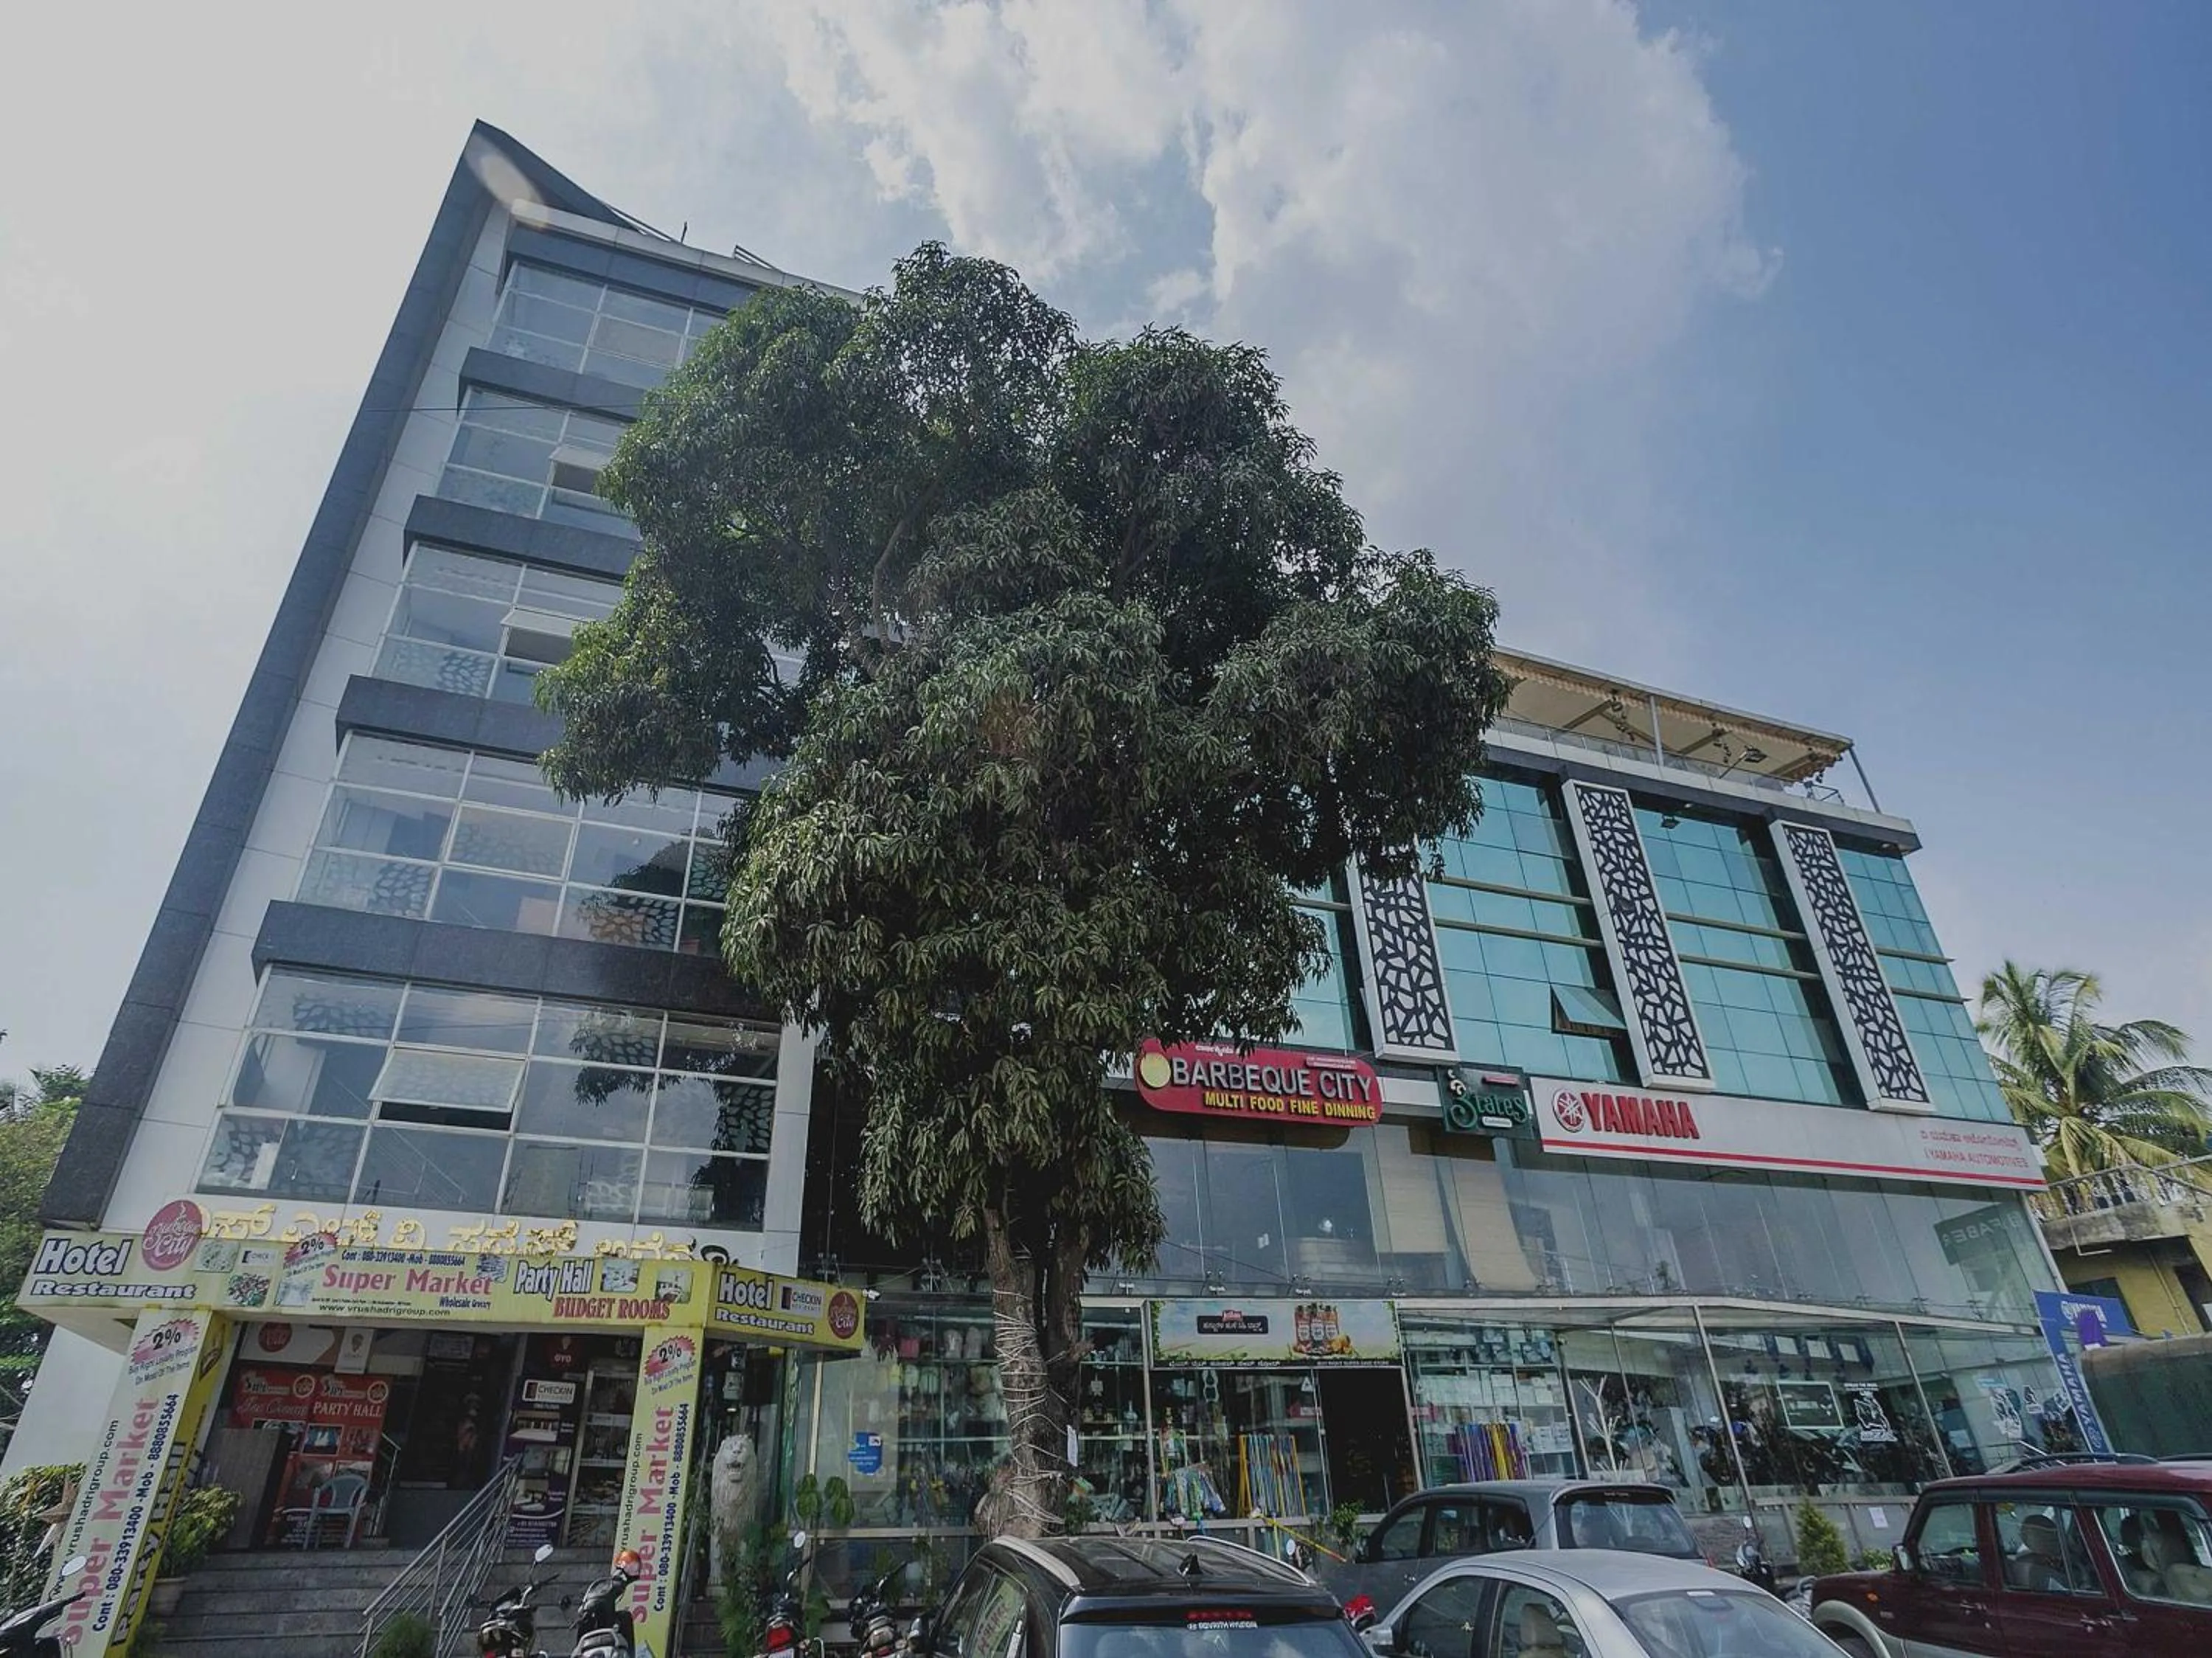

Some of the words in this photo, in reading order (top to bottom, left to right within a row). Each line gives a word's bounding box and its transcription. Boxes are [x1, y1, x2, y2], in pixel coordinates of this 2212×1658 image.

[1172, 1056, 1315, 1096] BARBEQUE
[1320, 1070, 1371, 1101] CITY
[1204, 1091, 1245, 1110] MULTI
[1249, 1095, 1284, 1112] FOOD
[1290, 1099, 1319, 1114] FINE
[1324, 1103, 1376, 1120] DINNING
[1581, 1092, 1700, 1139] YAMAHA
[34, 1238, 134, 1275] Hotel
[301, 1238, 325, 1255] 2%
[30, 1279, 198, 1300] Restaurant
[322, 1263, 397, 1294] Super
[406, 1268, 493, 1295] Market
[513, 1260, 560, 1303] Party
[559, 1259, 595, 1294] Hall
[717, 1271, 774, 1311] Hotel
[319, 1303, 451, 1317] www.vrushadrigroup.com
[553, 1297, 616, 1319] BUDGET
[617, 1298, 672, 1320] ROOMS
[715, 1307, 815, 1335] Restaurant
[153, 1327, 181, 1350] 2%
[659, 1344, 682, 1363] 2%
[538, 1385, 573, 1396] CHECKIN
[313, 1401, 352, 1417] PARTY
[353, 1404, 383, 1418] HALL
[90, 1398, 159, 1522] Market
[636, 1406, 674, 1516] Market
[93, 1602, 112, 1631] Cont
[106, 1506, 144, 1591] 080-33913400
[148, 1394, 179, 1461] 8880855664
[653, 1584, 664, 1612] Cont
[659, 1502, 677, 1576] 080-33913400
